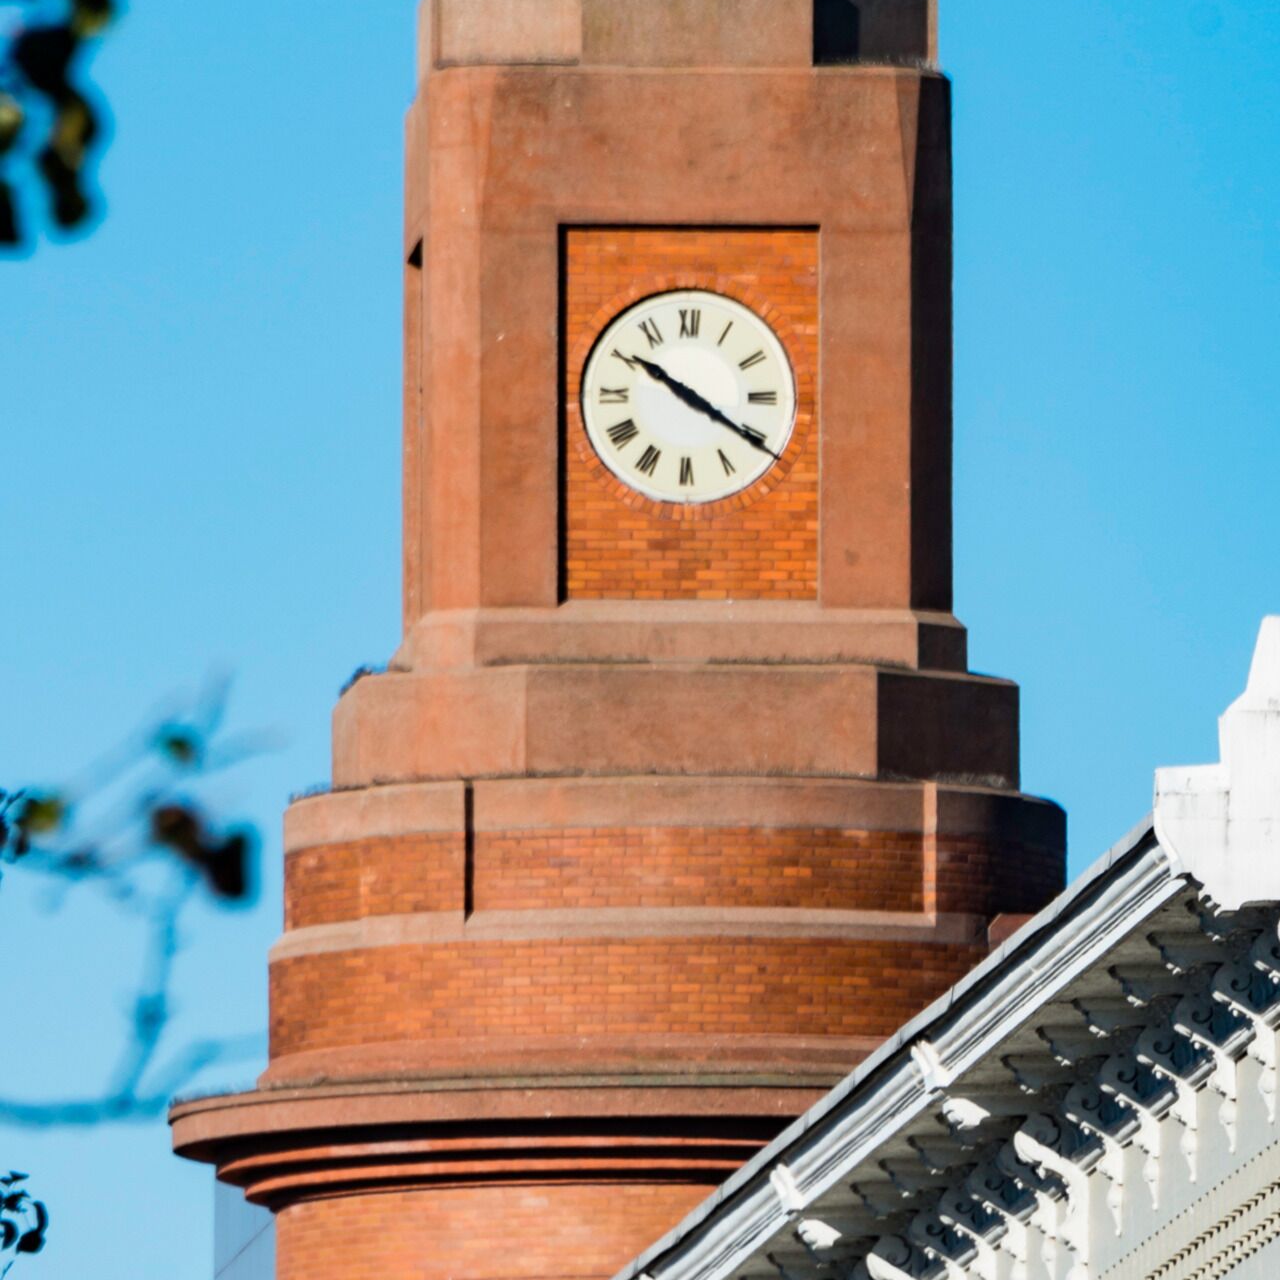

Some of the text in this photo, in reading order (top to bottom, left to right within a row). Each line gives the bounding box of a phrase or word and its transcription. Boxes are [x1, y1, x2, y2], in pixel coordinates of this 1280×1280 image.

[638, 317, 664, 349] XI
[679, 309, 701, 338] XII
[717, 321, 733, 347] I
[738, 349, 766, 371] II
[599, 387, 629, 404] IX
[747, 391, 777, 405] III
[606, 418, 639, 451] VIII
[635, 444, 662, 477] VII
[679, 457, 694, 486] VI
[716, 448, 736, 477] V
